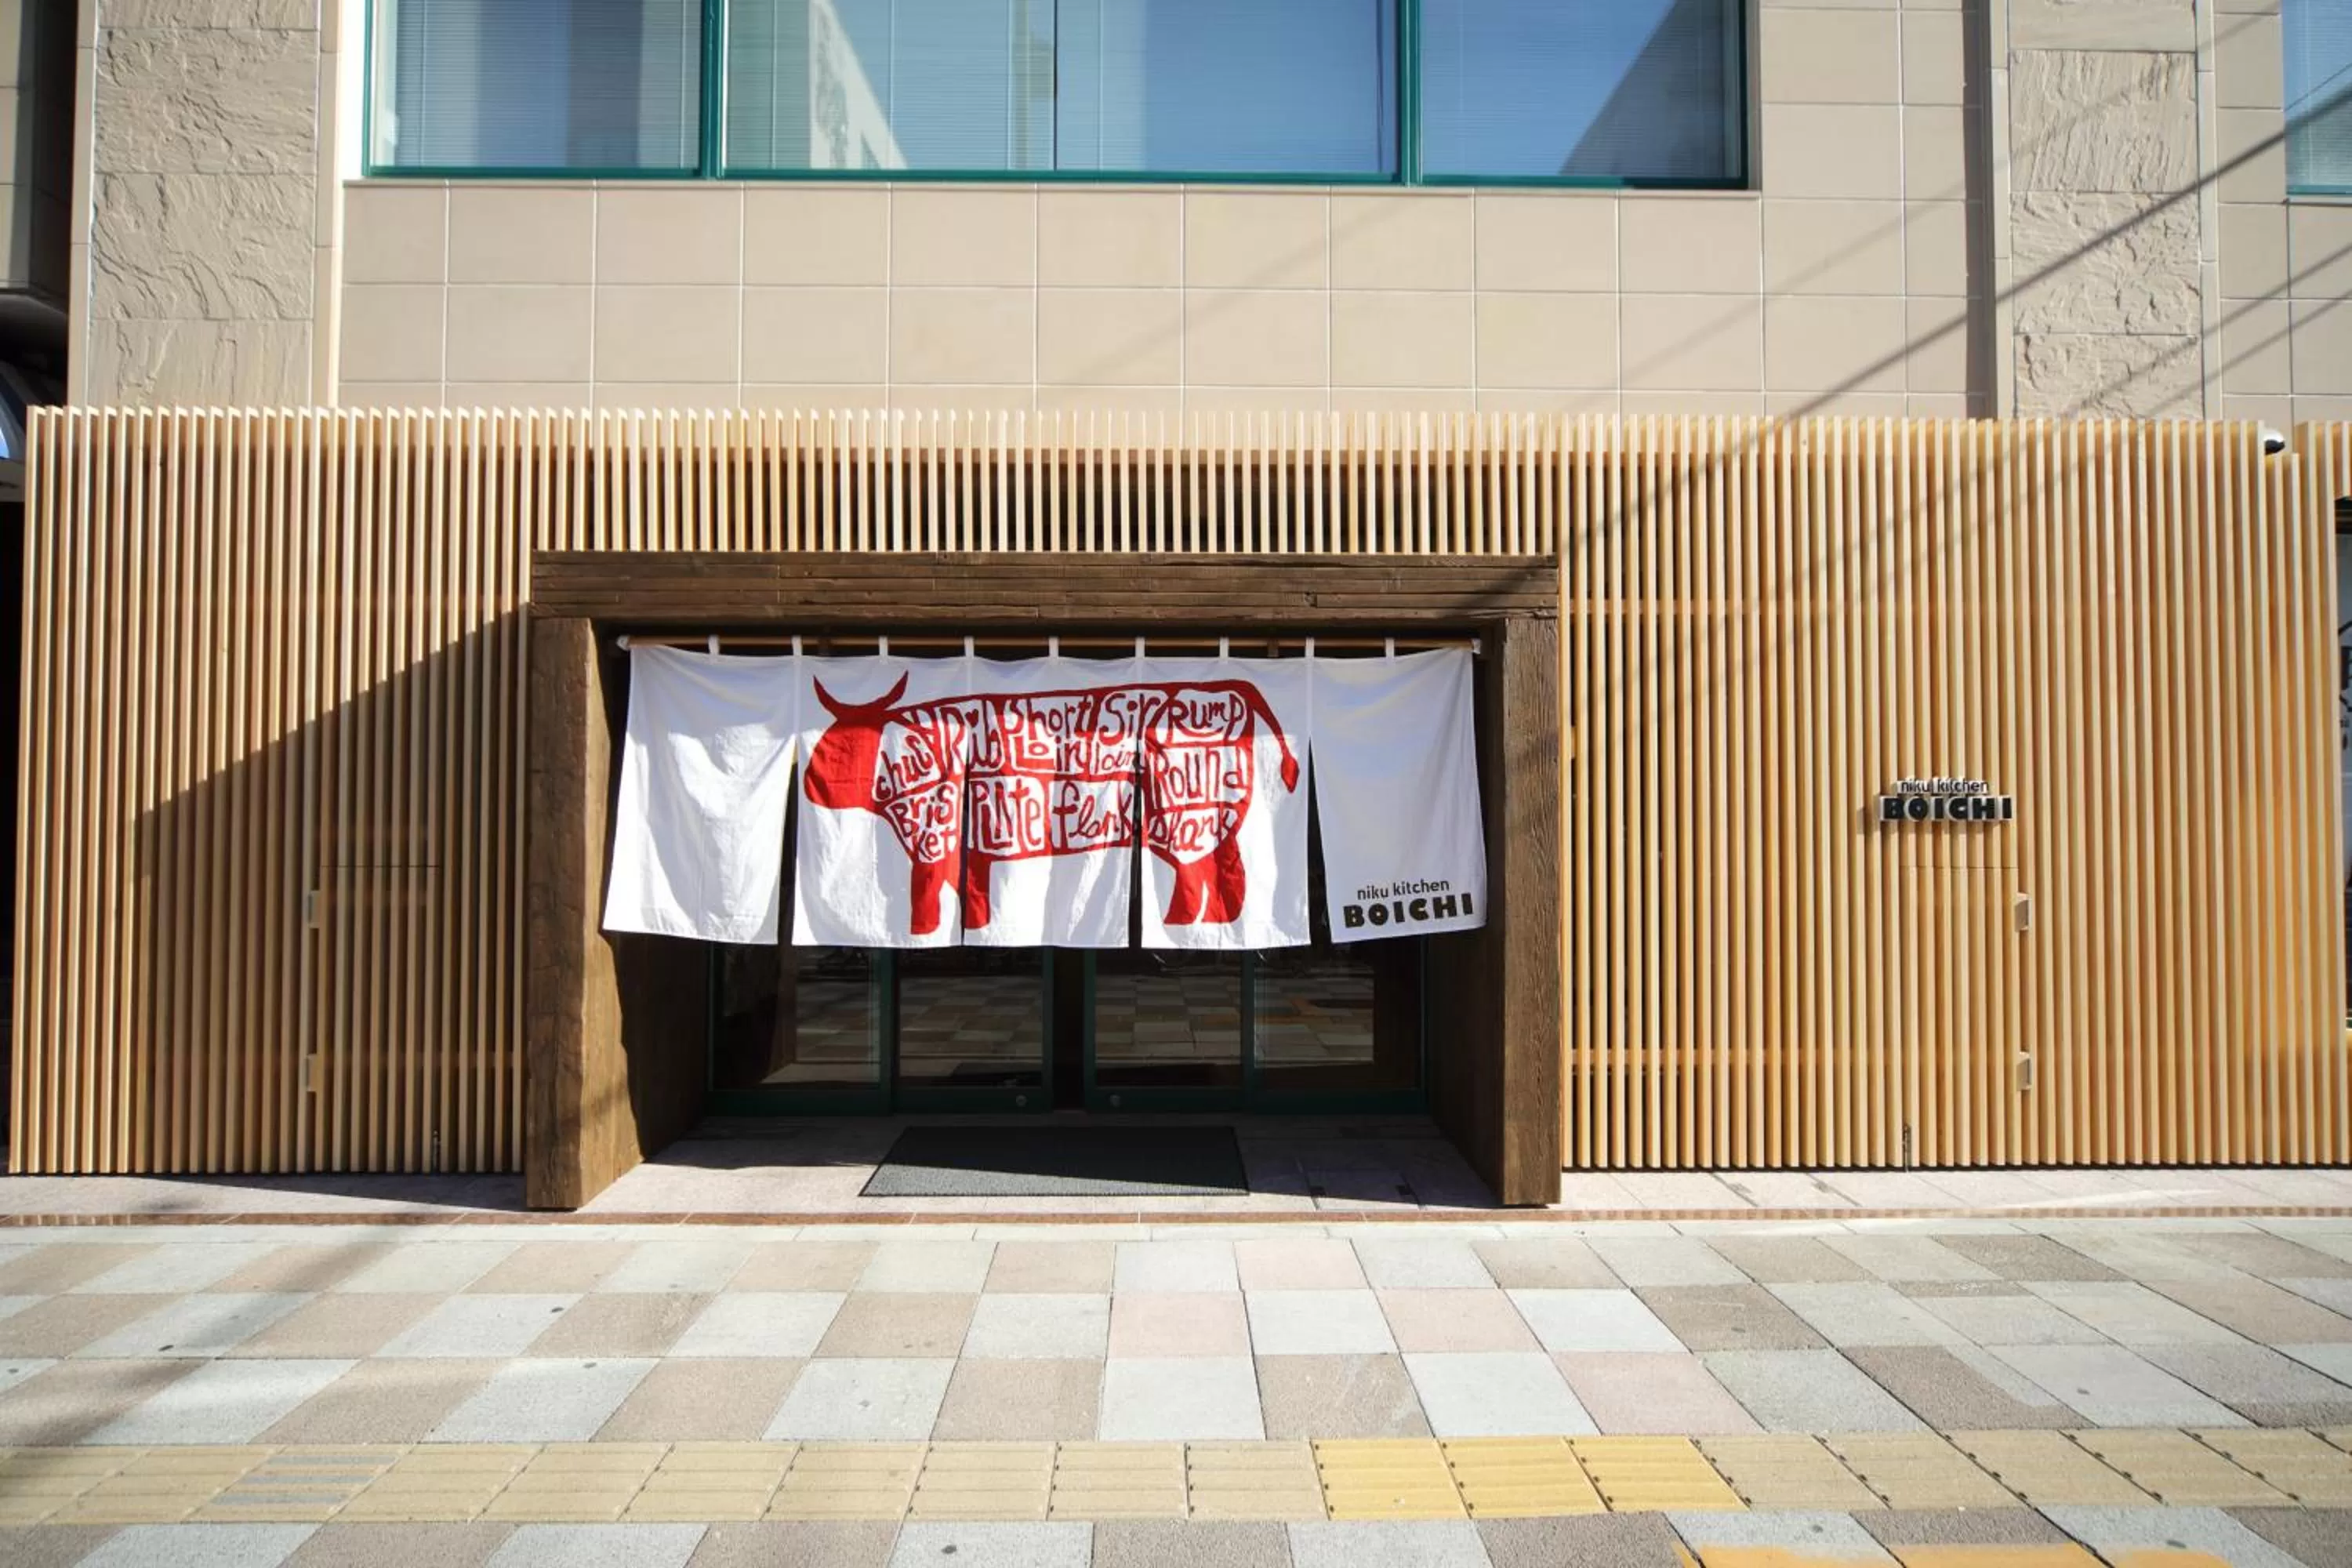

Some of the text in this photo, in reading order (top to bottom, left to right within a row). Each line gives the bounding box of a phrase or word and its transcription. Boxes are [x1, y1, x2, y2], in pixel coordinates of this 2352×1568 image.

[940, 700, 1004, 770] Rib
[1098, 692, 1162, 746] Sir
[1166, 692, 1246, 742] Rump
[1900, 776, 1989, 793] niku kitchen
[1882, 797, 2013, 820] BOICHI
[1357, 878, 1450, 901] niku kitchen
[1343, 892, 1473, 928] BOICHI
